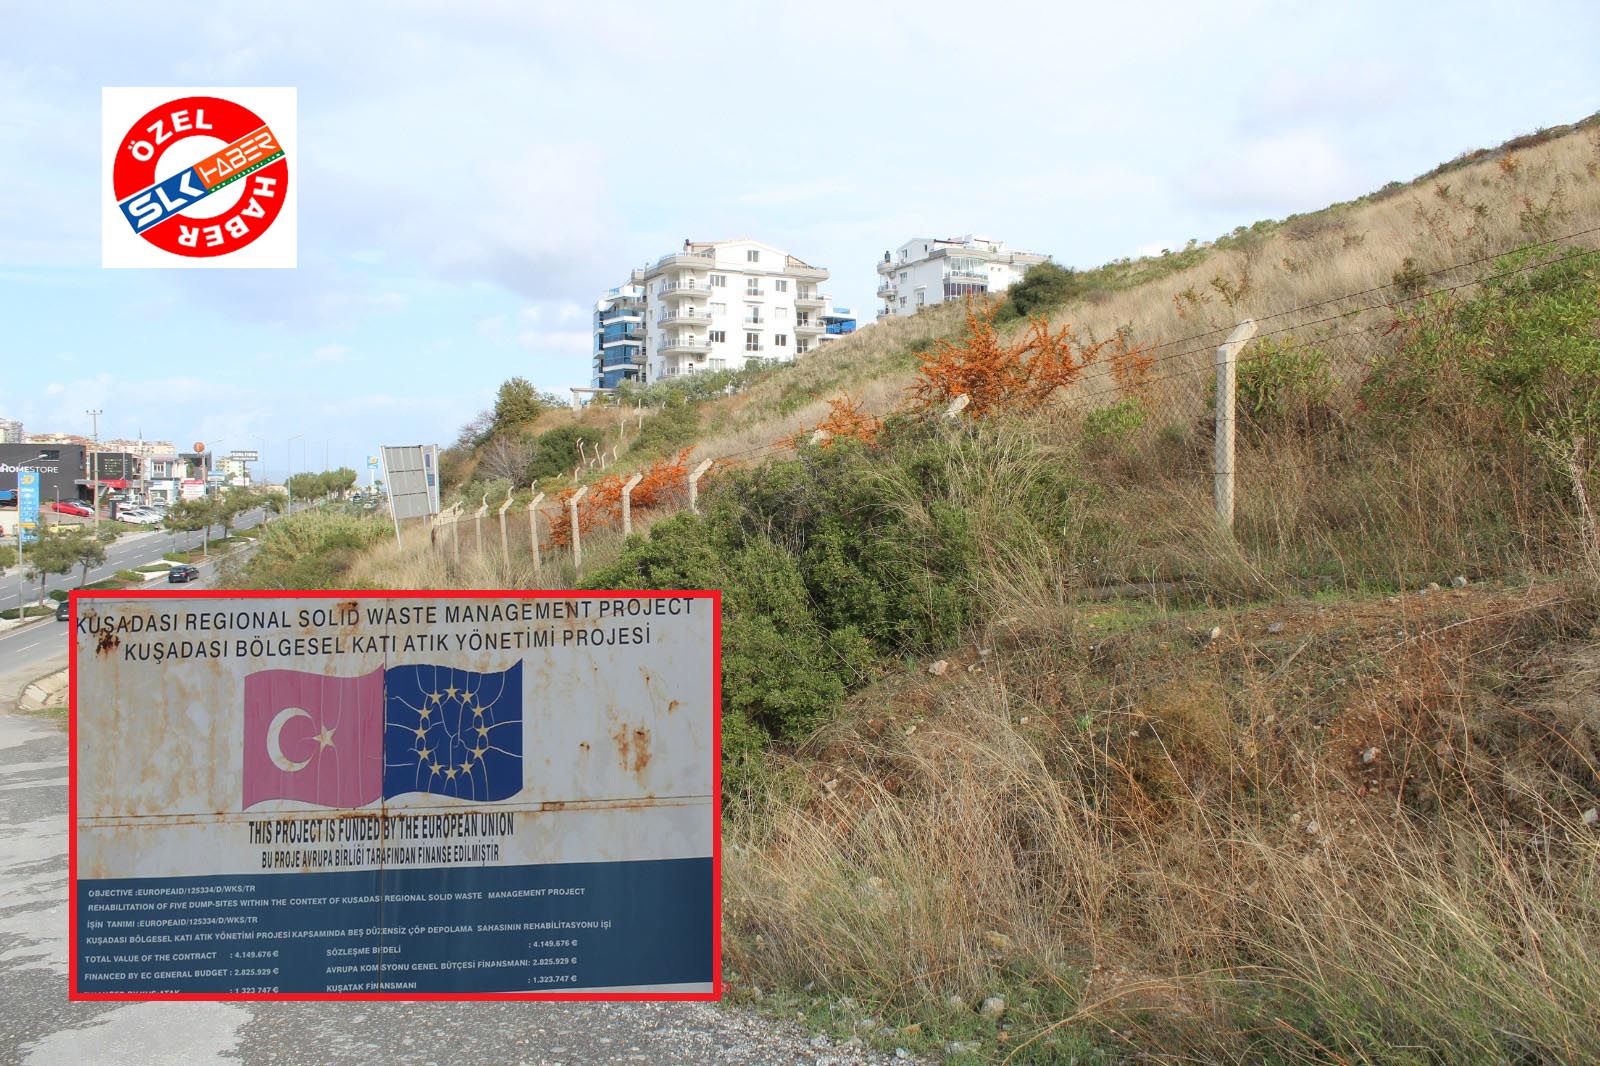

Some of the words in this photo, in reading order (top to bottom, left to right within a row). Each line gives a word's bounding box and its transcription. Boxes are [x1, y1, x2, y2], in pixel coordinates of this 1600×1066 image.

[185, 610, 291, 630] REGIONAL
[298, 608, 360, 628] SOLID
[368, 606, 437, 625] WASTE
[445, 601, 592, 623] MANAGEMENT
[600, 598, 694, 618] PROJECT
[125, 640, 228, 665] KUŞADASI
[236, 635, 345, 657] BÖLGESEL
[352, 635, 396, 653] KATI
[403, 633, 448, 652] ATIK
[456, 625, 554, 651] YÖNETİMİ
[563, 622, 651, 647] PROJESİ
[249, 820, 272, 844] THIS
[275, 818, 322, 844] PROJECT
[325, 818, 335, 842] IS
[339, 816, 380, 842] FUNDED
[383, 815, 396, 840] BY
[400, 815, 418, 840] THE
[422, 813, 477, 839] EUROPEAN
[481, 812, 514, 837] UNION
[262, 851, 272, 868] BU
[275, 850, 300, 868] PROJE
[302, 849, 333, 867] AVRUPA
[335, 844, 364, 866] BİRLİĞİ
[367, 846, 416, 865] TARAFINDAN
[418, 841, 452, 864] FİNANSE
[454, 839, 499, 866] EDİLMİŞTİR
[88, 888, 133, 897] OBJECTIVE
[88, 903, 155, 912] REHABILITATION
[156, 902, 168, 910] OF
[170, 901, 187, 910] FIVE
[189, 899, 238, 909] DUMP-SITES
[240, 898, 269, 907] WITHIN
[272, 898, 287, 906] THE
[289, 897, 327, 906] CONTEXT
[329, 897, 340, 905] OF
[385, 894, 426, 903] REGIONAL
[428, 893, 452, 901] SOLID
[455, 891, 483, 900] WASTE
[488, 889, 546, 899] MANAGEMENT
[548, 887, 585, 896] PROJECT
[86, 936, 127, 946] KUŞADASI
[129, 934, 173, 943] BÖLGESEL
[174, 934, 192, 942] KATI
[194, 933, 212, 941] ATIK
[214, 930, 254, 941] YÖNETİMİ
[256, 929, 291, 939] PROJESİ
[291, 928, 346, 938] KAPSAMINDA
[348, 928, 364, 938] BEŞ
[408, 926, 426, 936] ÇÖP
[427, 925, 473, 934] DEPOLAMA
[477, 923, 522, 932] SAHASININ
[523, 920, 599, 931] REHABİLİTASYONU
[107, 920, 135, 928] TANIMI
[84, 955, 112, 963] TOTAL
[113, 954, 139, 962] VALUE
[141, 954, 153, 962] OF
[155, 953, 170, 961] THE
[172, 952, 217, 961] CONTRACT
[326, 946, 370, 957] SÖZLEŞME
[84, 972, 126, 981] FINANCED
[128, 972, 139, 980] BY
[154, 971, 193, 979] GENERAL
[194, 969, 227, 977] BUDGET
[234, 968, 271, 976] 2.825.929
[326, 966, 359, 974] AVRUPA
[360, 963, 410, 972] KOMSYONU
[411, 963, 439, 971] GENEL
[441, 959, 476, 970] BÜTÇESİ
[532, 958, 569, 966] 2.825.929
[326, 983, 364, 993] KUŞATAK
[365, 981, 417, 990] FİNANSMANI
[533, 975, 569, 984] 1.323.747
